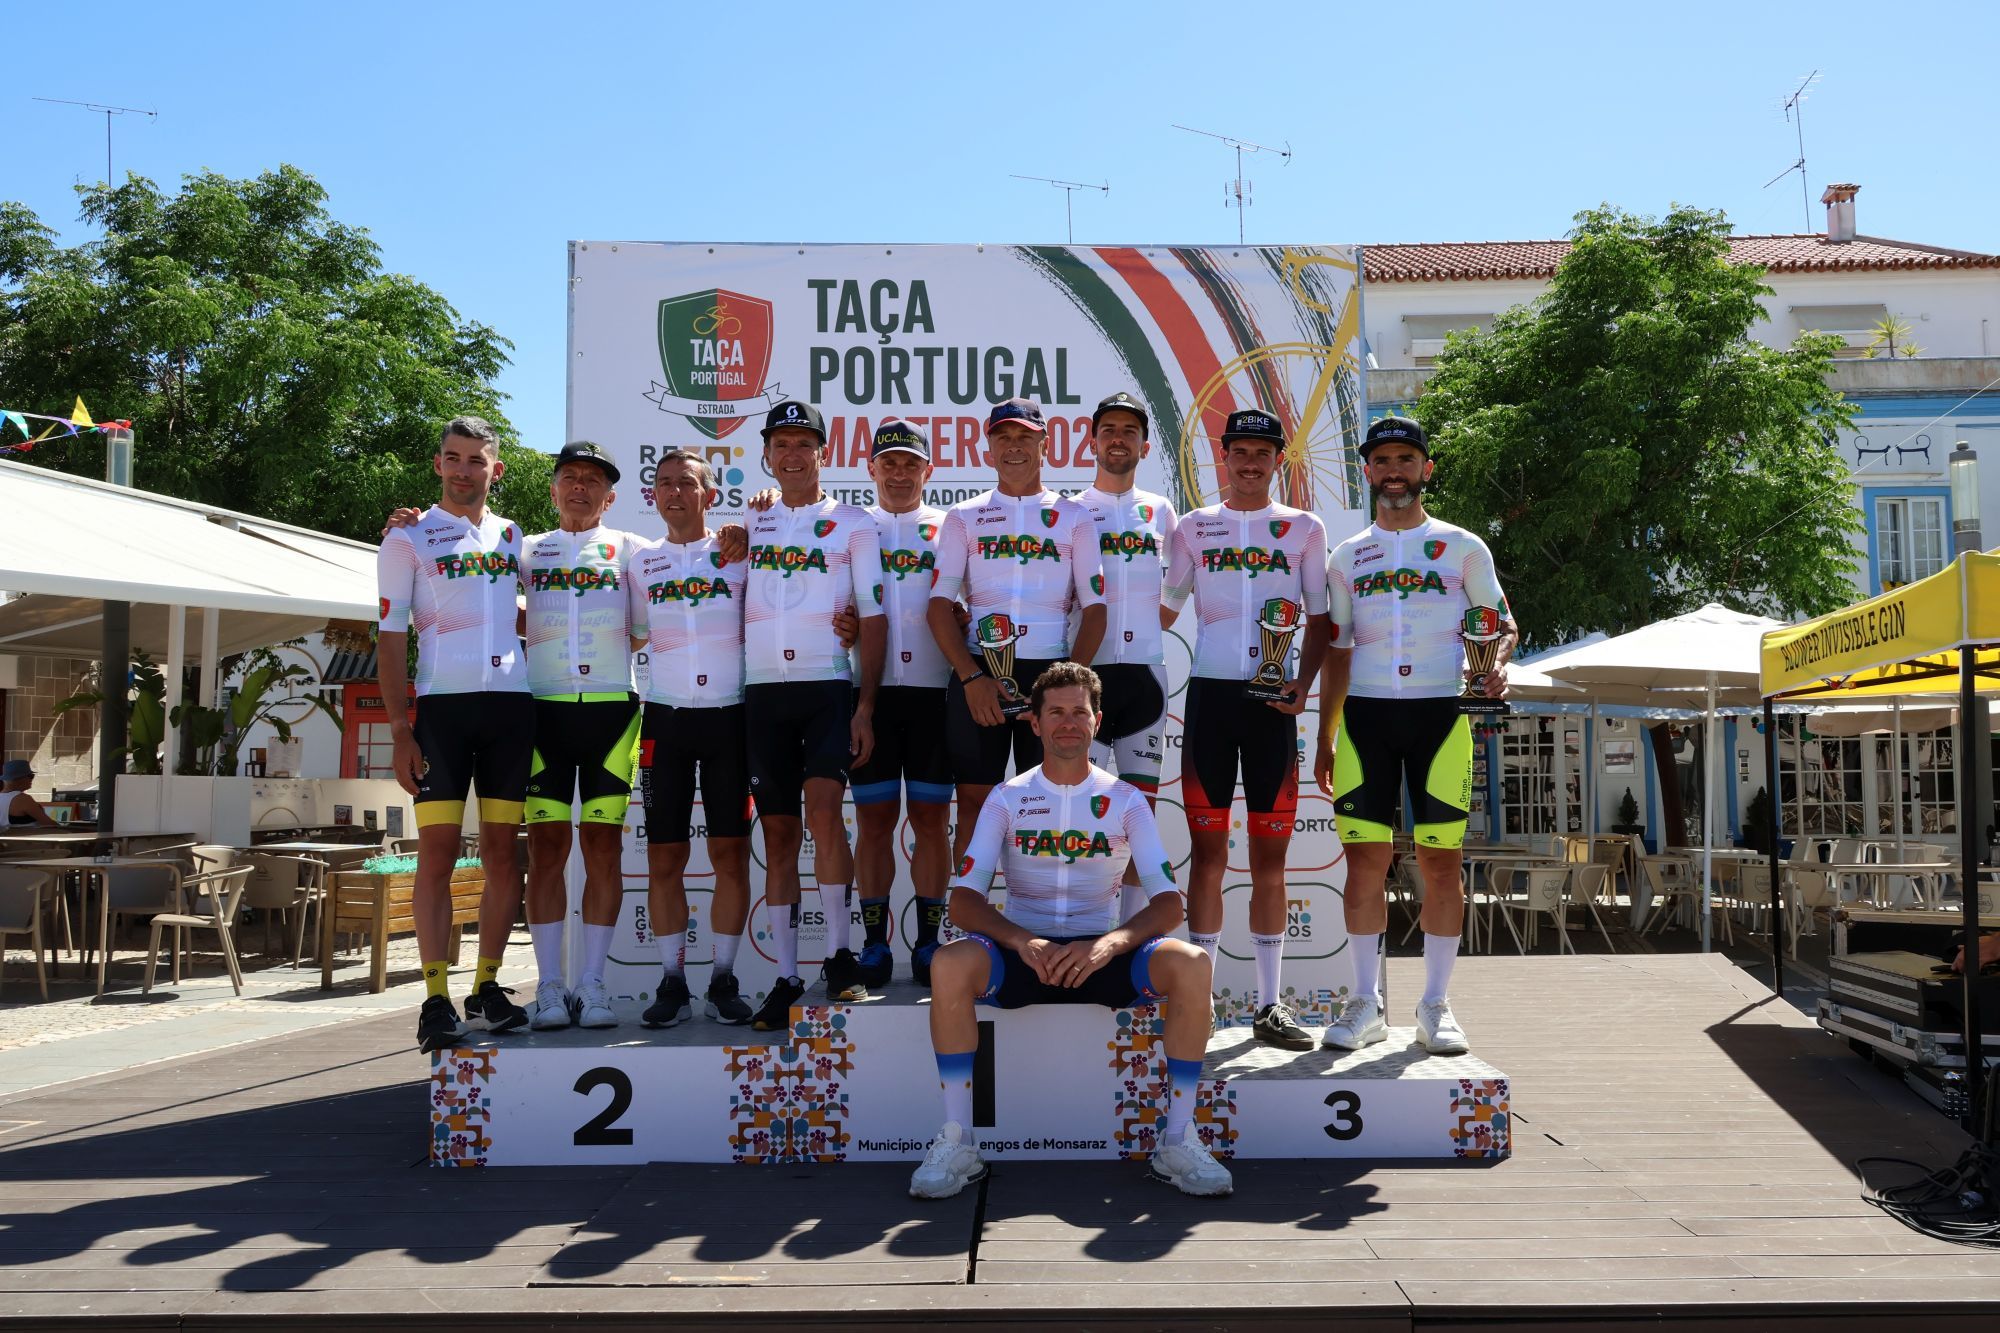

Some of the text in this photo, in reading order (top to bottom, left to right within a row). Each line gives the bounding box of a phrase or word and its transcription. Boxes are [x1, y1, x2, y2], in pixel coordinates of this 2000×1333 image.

[807, 279, 935, 344] TAÇA
[690, 339, 744, 370] TAÇA
[691, 371, 747, 385] PORTUGAL
[810, 346, 1081, 405] PORTUGAL
[697, 404, 735, 414] ESTRADA
[877, 432, 900, 445] UCA
[1099, 531, 1157, 562] AÇA
[1820, 611, 1878, 659] INVISIBLE
[1879, 601, 1905, 642] GIN
[1294, 818, 1337, 832] ORTO
[1015, 830, 1112, 864] TAÇA
[865, 904, 882, 926] UCA
[927, 905, 944, 926] UCA
[573, 1066, 634, 1146] 2
[1323, 1090, 1363, 1141] 3
[858, 1137, 1107, 1153] Município d engos de Monsaraz
